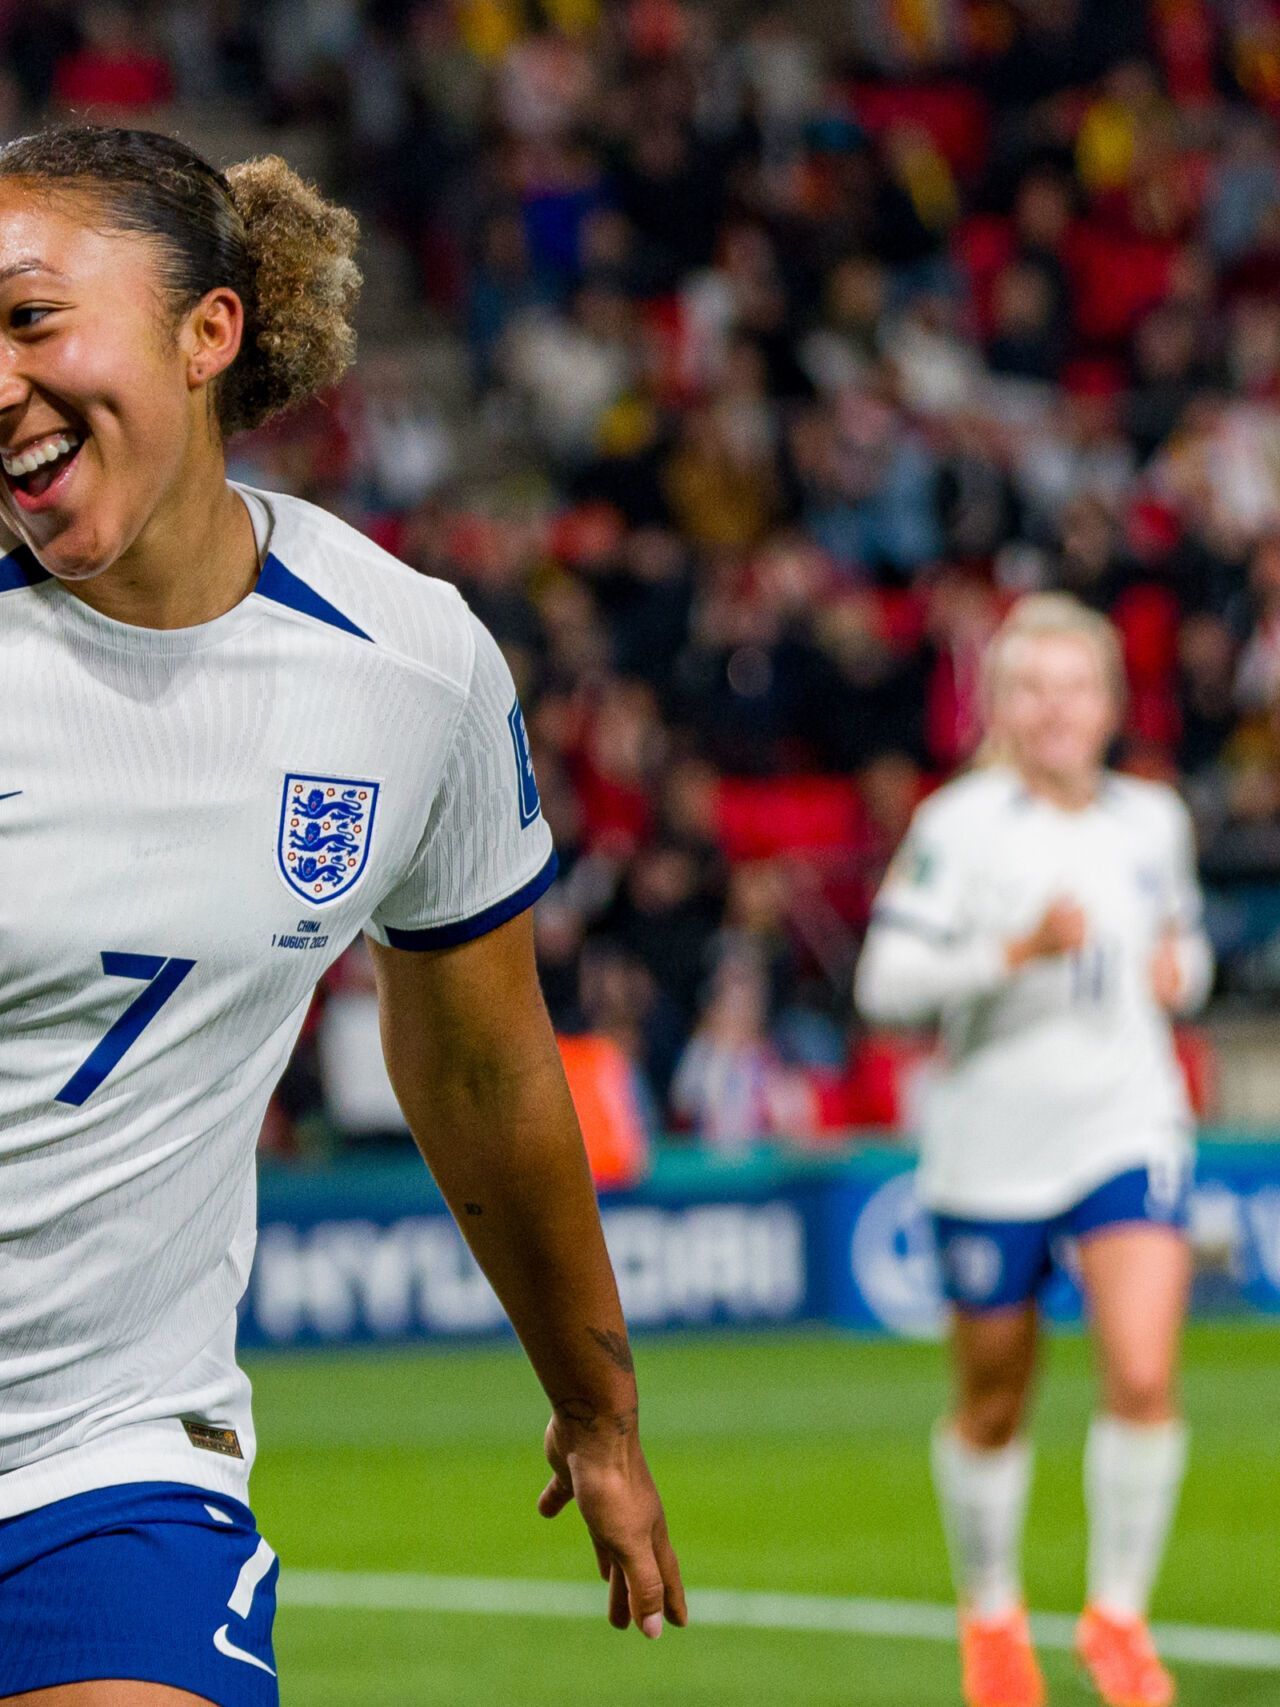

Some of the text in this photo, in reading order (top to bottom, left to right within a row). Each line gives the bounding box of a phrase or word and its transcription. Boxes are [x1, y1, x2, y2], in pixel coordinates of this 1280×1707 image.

[297, 920, 321, 933] CHINA
[271, 934, 329, 950] 1 AUGUST 2023
[53, 951, 198, 1107] 7
